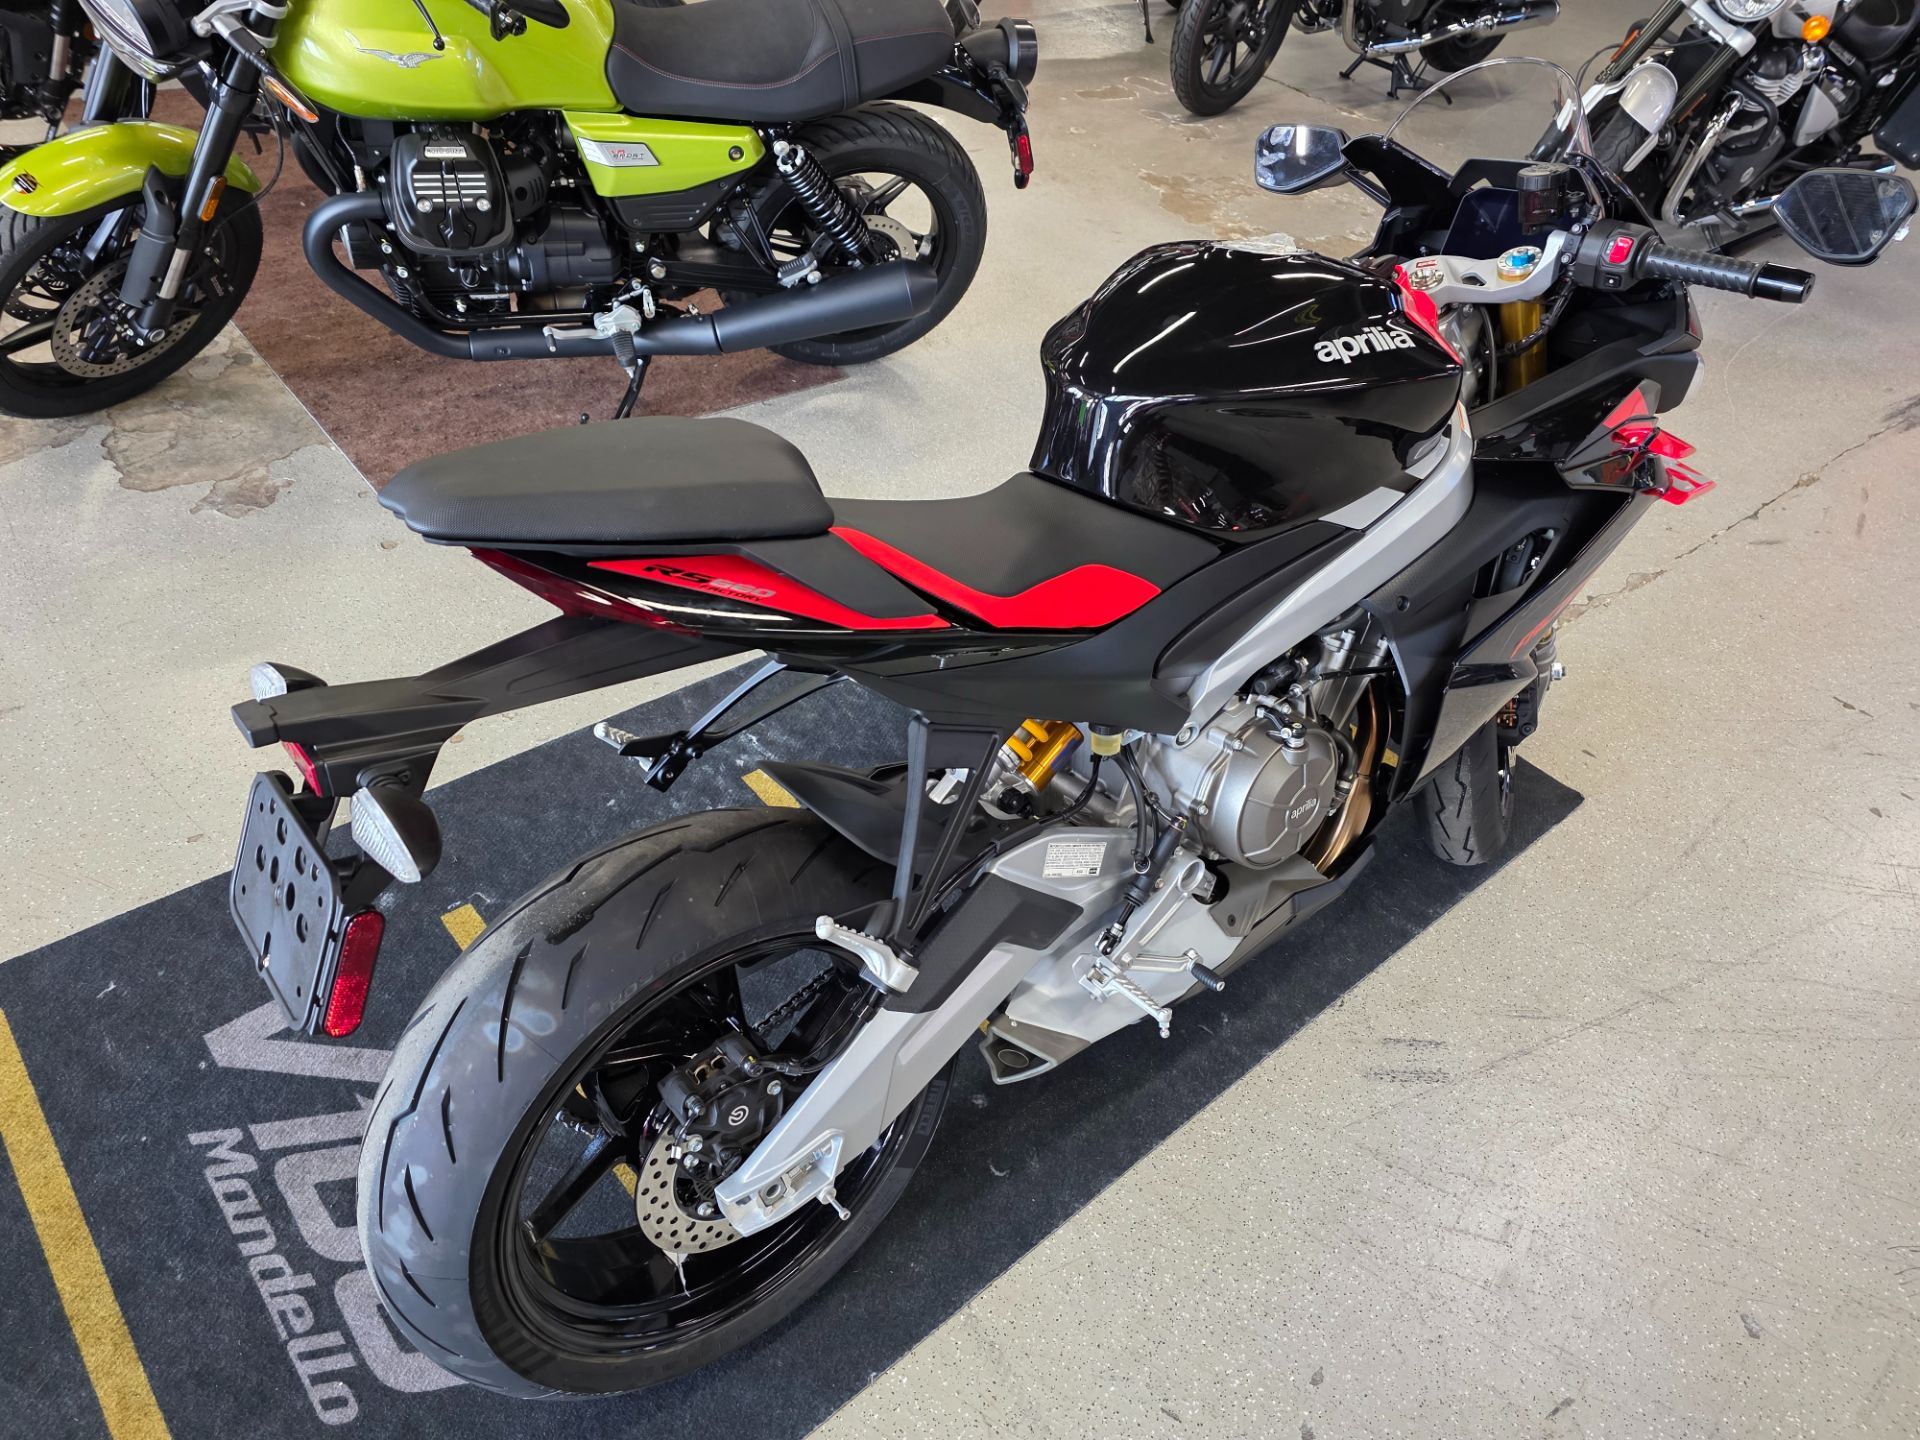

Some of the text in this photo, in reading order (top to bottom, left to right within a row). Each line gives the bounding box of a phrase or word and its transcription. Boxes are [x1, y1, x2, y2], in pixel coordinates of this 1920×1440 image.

[1314, 326, 1416, 364] aprilia
[700, 584, 761, 602] FACTORY
[1290, 798, 1317, 819] aprilia
[188, 1127, 358, 1425] Mandello
